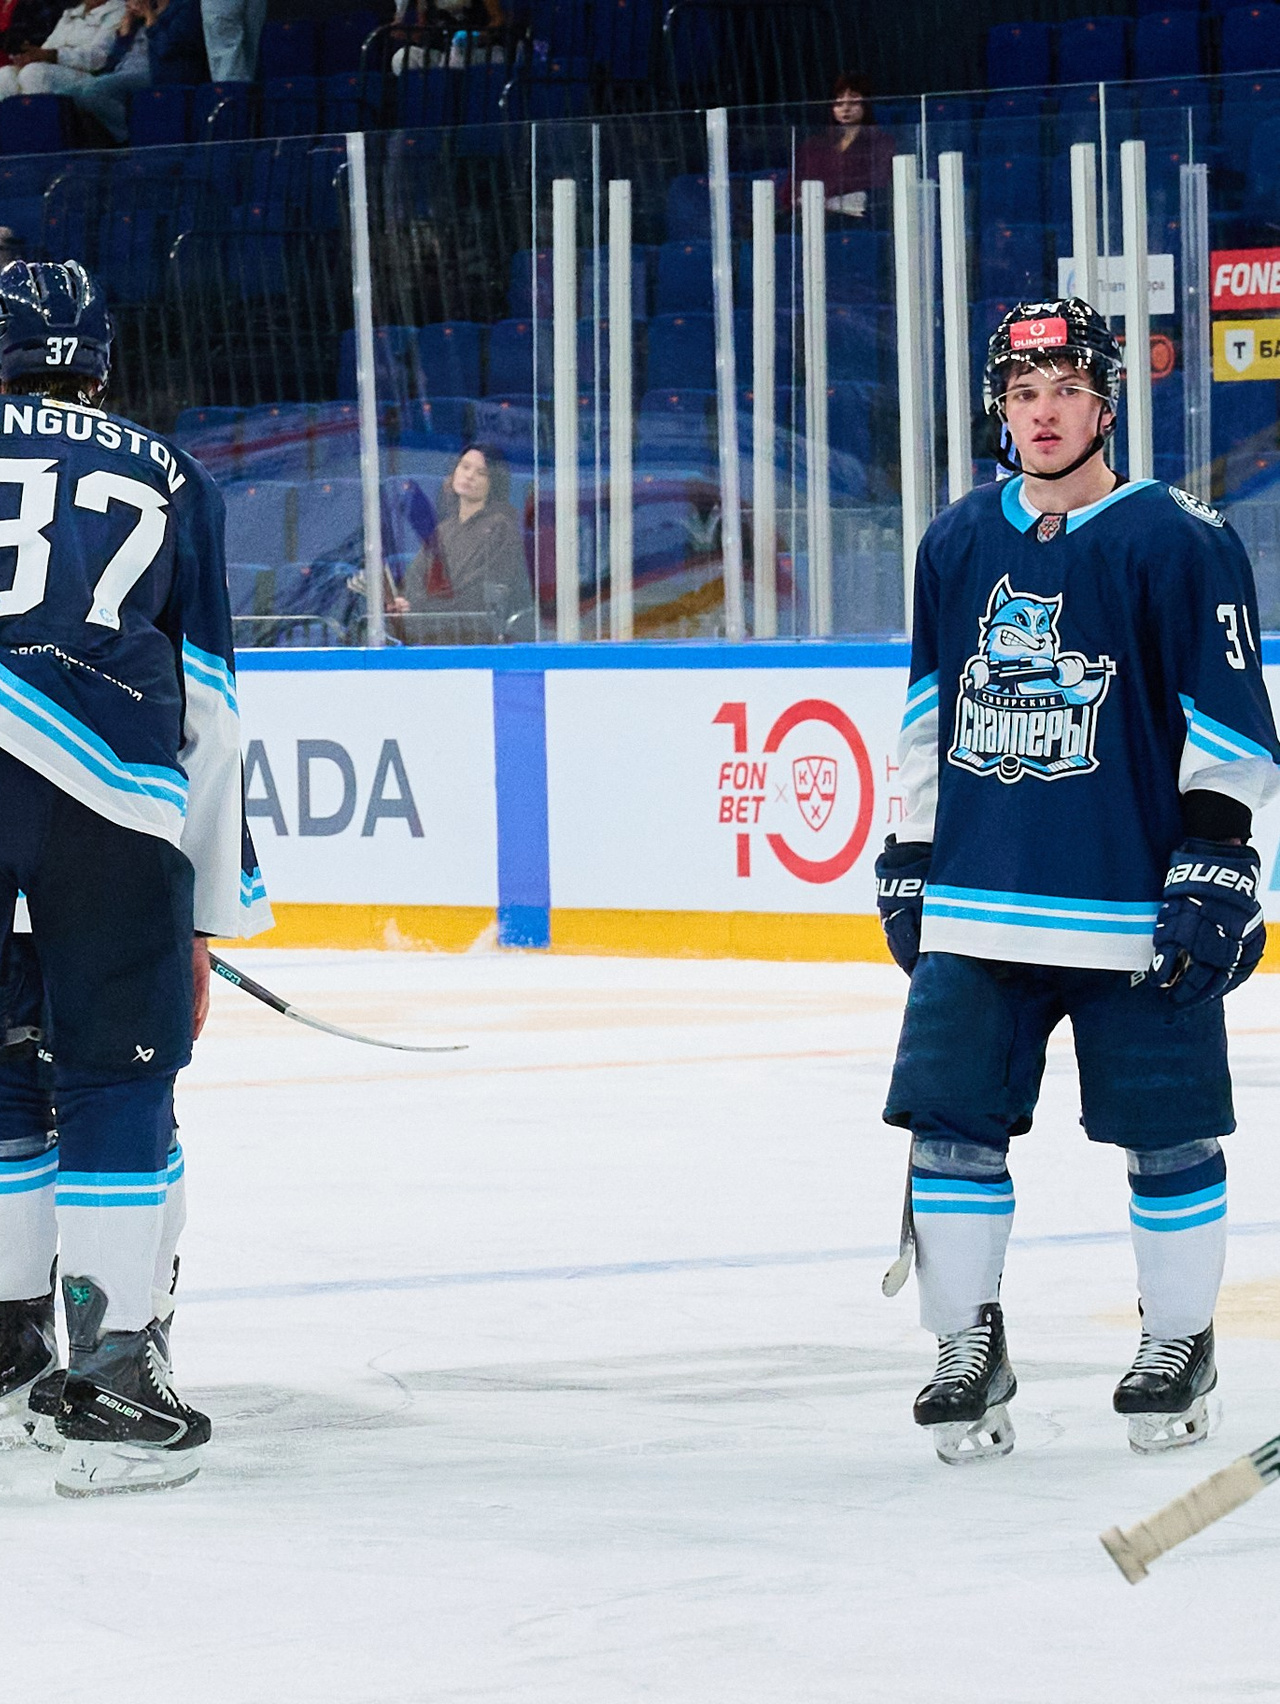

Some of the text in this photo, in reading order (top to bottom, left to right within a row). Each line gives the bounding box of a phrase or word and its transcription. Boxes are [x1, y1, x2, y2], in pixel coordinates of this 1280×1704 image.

[46, 337, 78, 365] 37
[1014, 336, 1063, 347] OLIMPBET
[982, 692, 1057, 707] СИБИРСКИЕ
[245, 739, 425, 838] ADA
[718, 762, 767, 790] FON
[718, 796, 766, 823] BET
